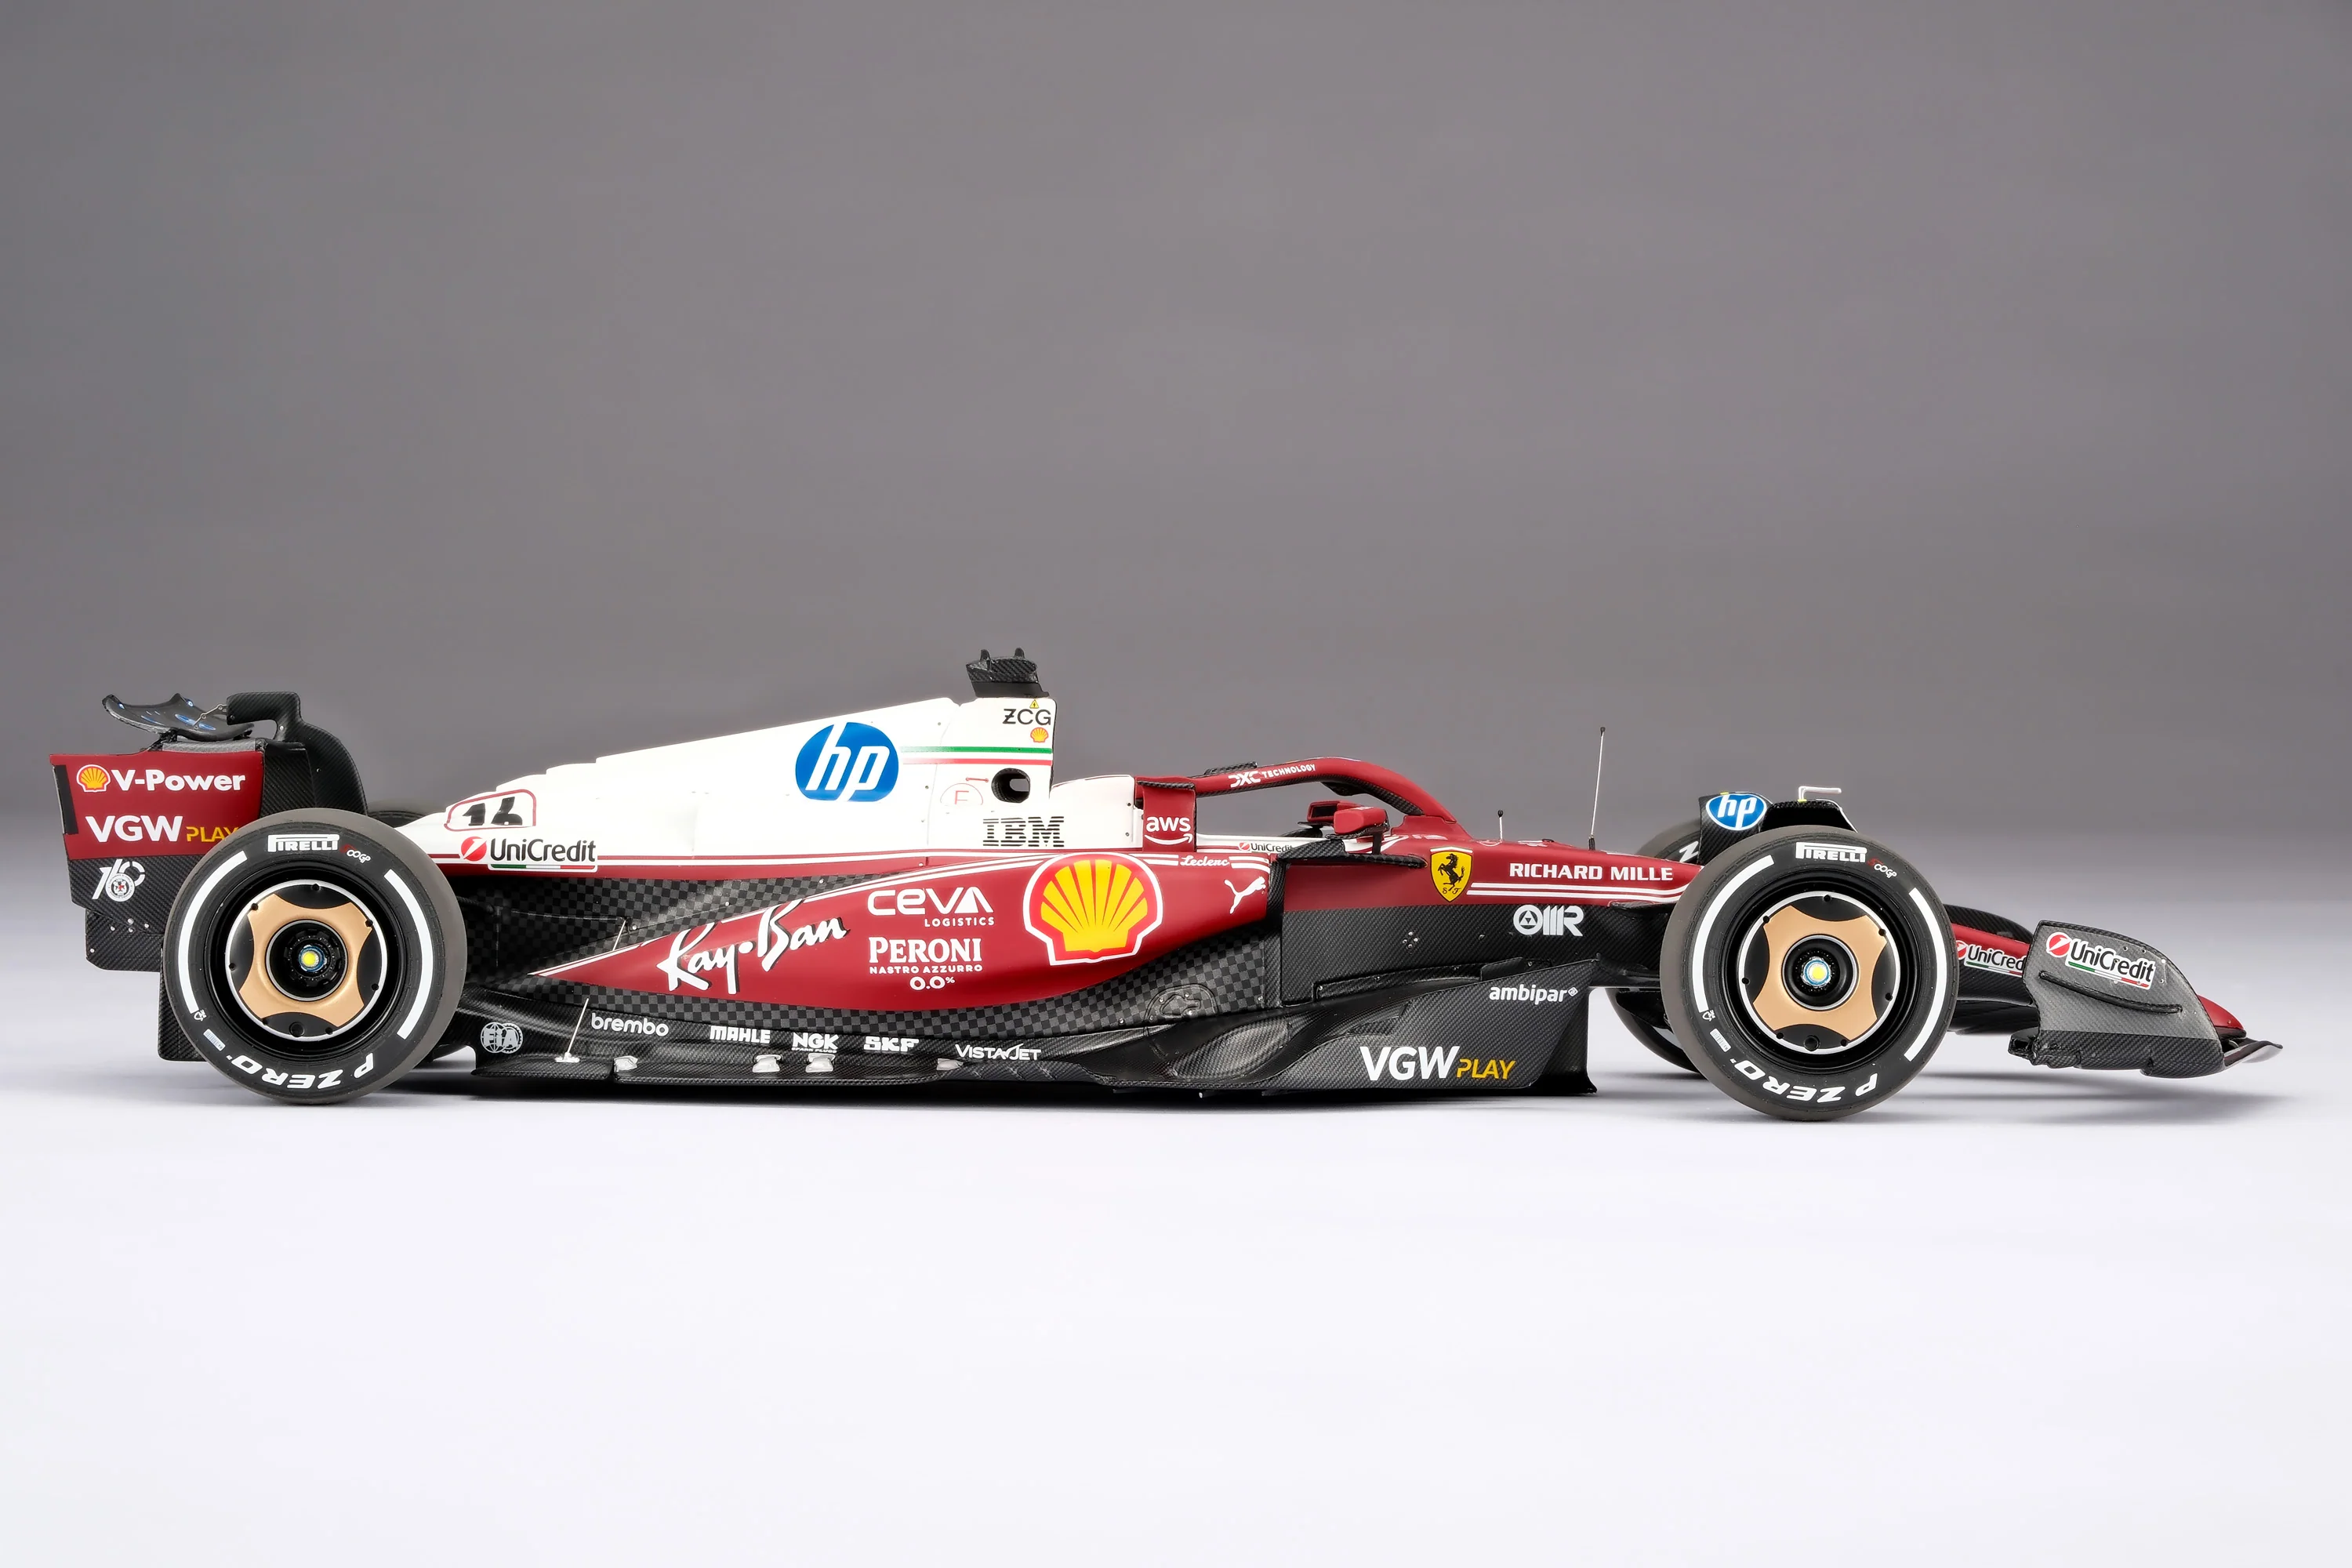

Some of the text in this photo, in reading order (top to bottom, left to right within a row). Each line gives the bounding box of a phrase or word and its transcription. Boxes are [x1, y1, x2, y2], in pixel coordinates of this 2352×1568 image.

[805, 722, 890, 800] hp
[111, 769, 245, 792] V-Power
[1228, 764, 1316, 788] DXC TECHNOLOGY
[1717, 794, 1758, 829] hp
[85, 815, 183, 843] VGW
[982, 816, 1065, 848] IBM
[1145, 816, 1191, 832] aws
[267, 833, 340, 853] PIRELLI
[490, 838, 597, 862] UniCredit
[1795, 841, 1867, 863] PIRELLI
[1179, 855, 1230, 867] Leclerc
[1509, 862, 1673, 881] RICHARD MILLE
[924, 916, 995, 927] LOGISTICS
[868, 936, 982, 964] PERONI
[1967, 946, 2027, 971] UniCred
[2071, 941, 2154, 982] UniCredit
[869, 964, 983, 975] NASTRO AZZURRO
[909, 975, 956, 991] 0.0%
[1489, 984, 1569, 1005] ambipar
[591, 1013, 670, 1036] brembo
[710, 1025, 771, 1044] MAHLE
[792, 1032, 839, 1051] NGK
[863, 1036, 920, 1052] SKF
[354, 1052, 374, 1079] P
[1359, 1045, 1516, 1081] VGW PLAY
[1855, 1073, 1878, 1097] P
